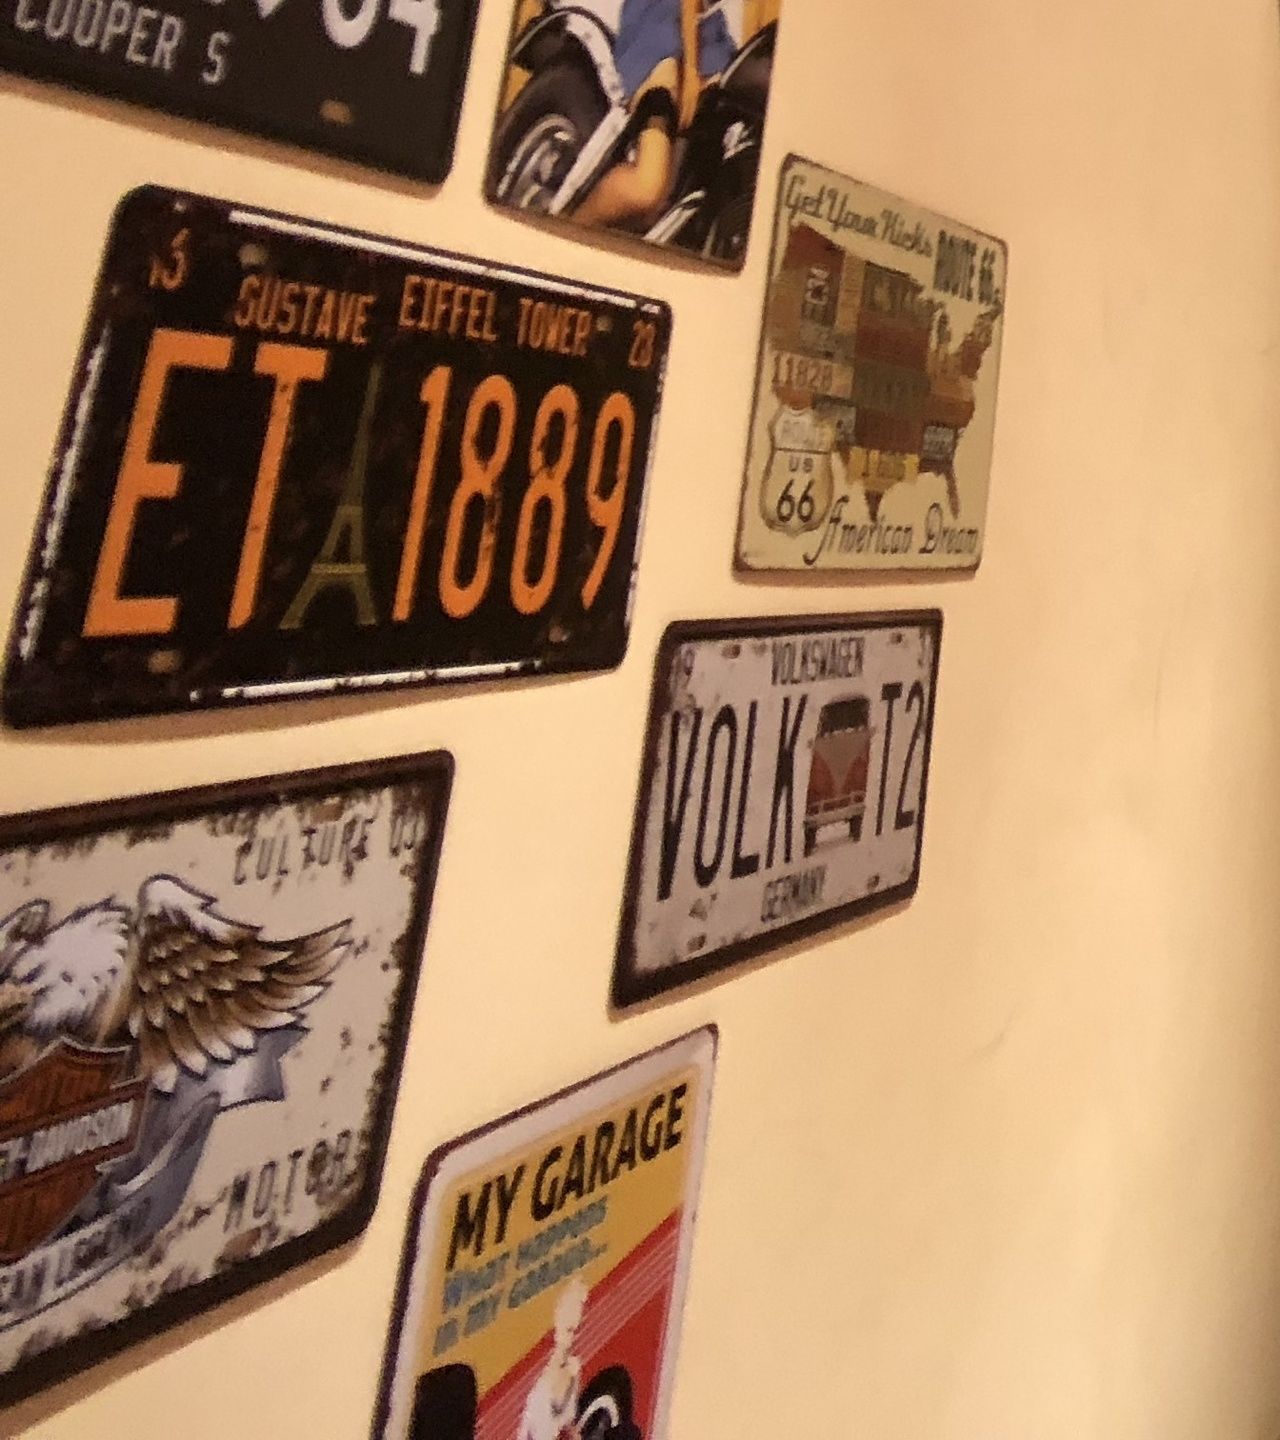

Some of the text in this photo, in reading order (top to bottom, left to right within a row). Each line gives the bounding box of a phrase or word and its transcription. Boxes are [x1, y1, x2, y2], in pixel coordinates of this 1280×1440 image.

[202, 31, 231, 86] S
[785, 173, 826, 222] Get
[233, 274, 594, 357] GUSTAVE EIFFEL TOWER
[81, 327, 636, 638] ET 1889
[776, 479, 816, 523] 66
[802, 494, 913, 566] American
[657, 680, 926, 902] VOLK T2
[445, 1082, 688, 1271] MY GARAGE
